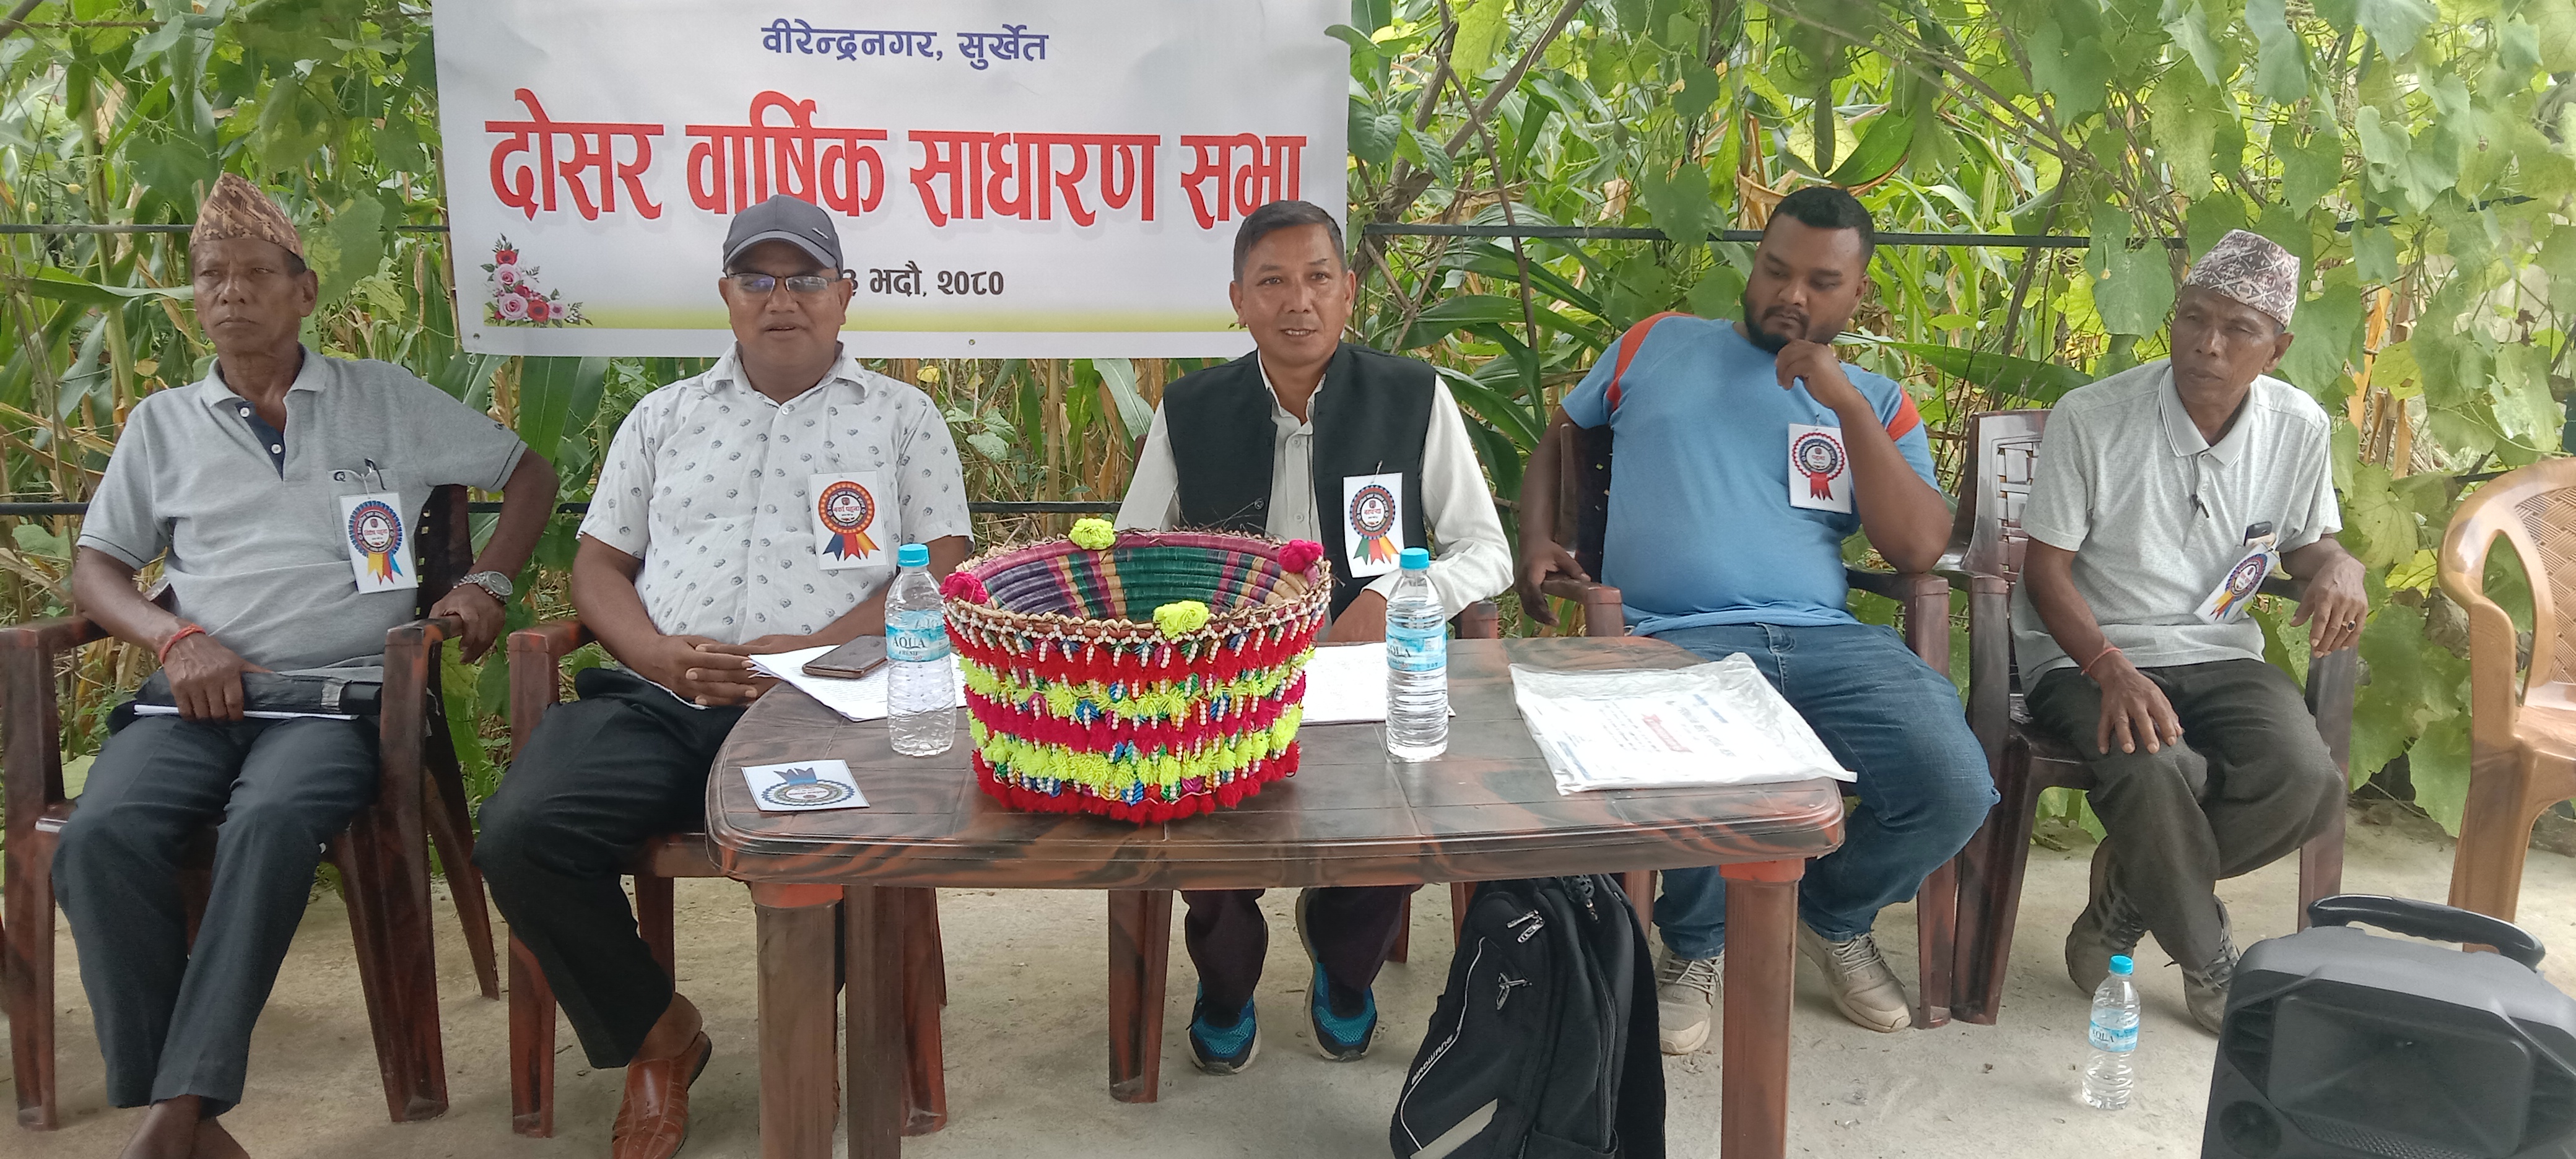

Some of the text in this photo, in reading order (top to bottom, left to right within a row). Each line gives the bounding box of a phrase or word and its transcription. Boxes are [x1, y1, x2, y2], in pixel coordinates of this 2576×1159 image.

[762, 18, 1050, 70] वीरेन्द्रनगर, सुर्खेत
[485, 89, 1307, 229] दोसर वार्षिक साधारण सभा
[869, 260, 928, 297] भदौ,
[937, 271, 1004, 295] २०८०
[892, 636, 926, 649] AQUA
